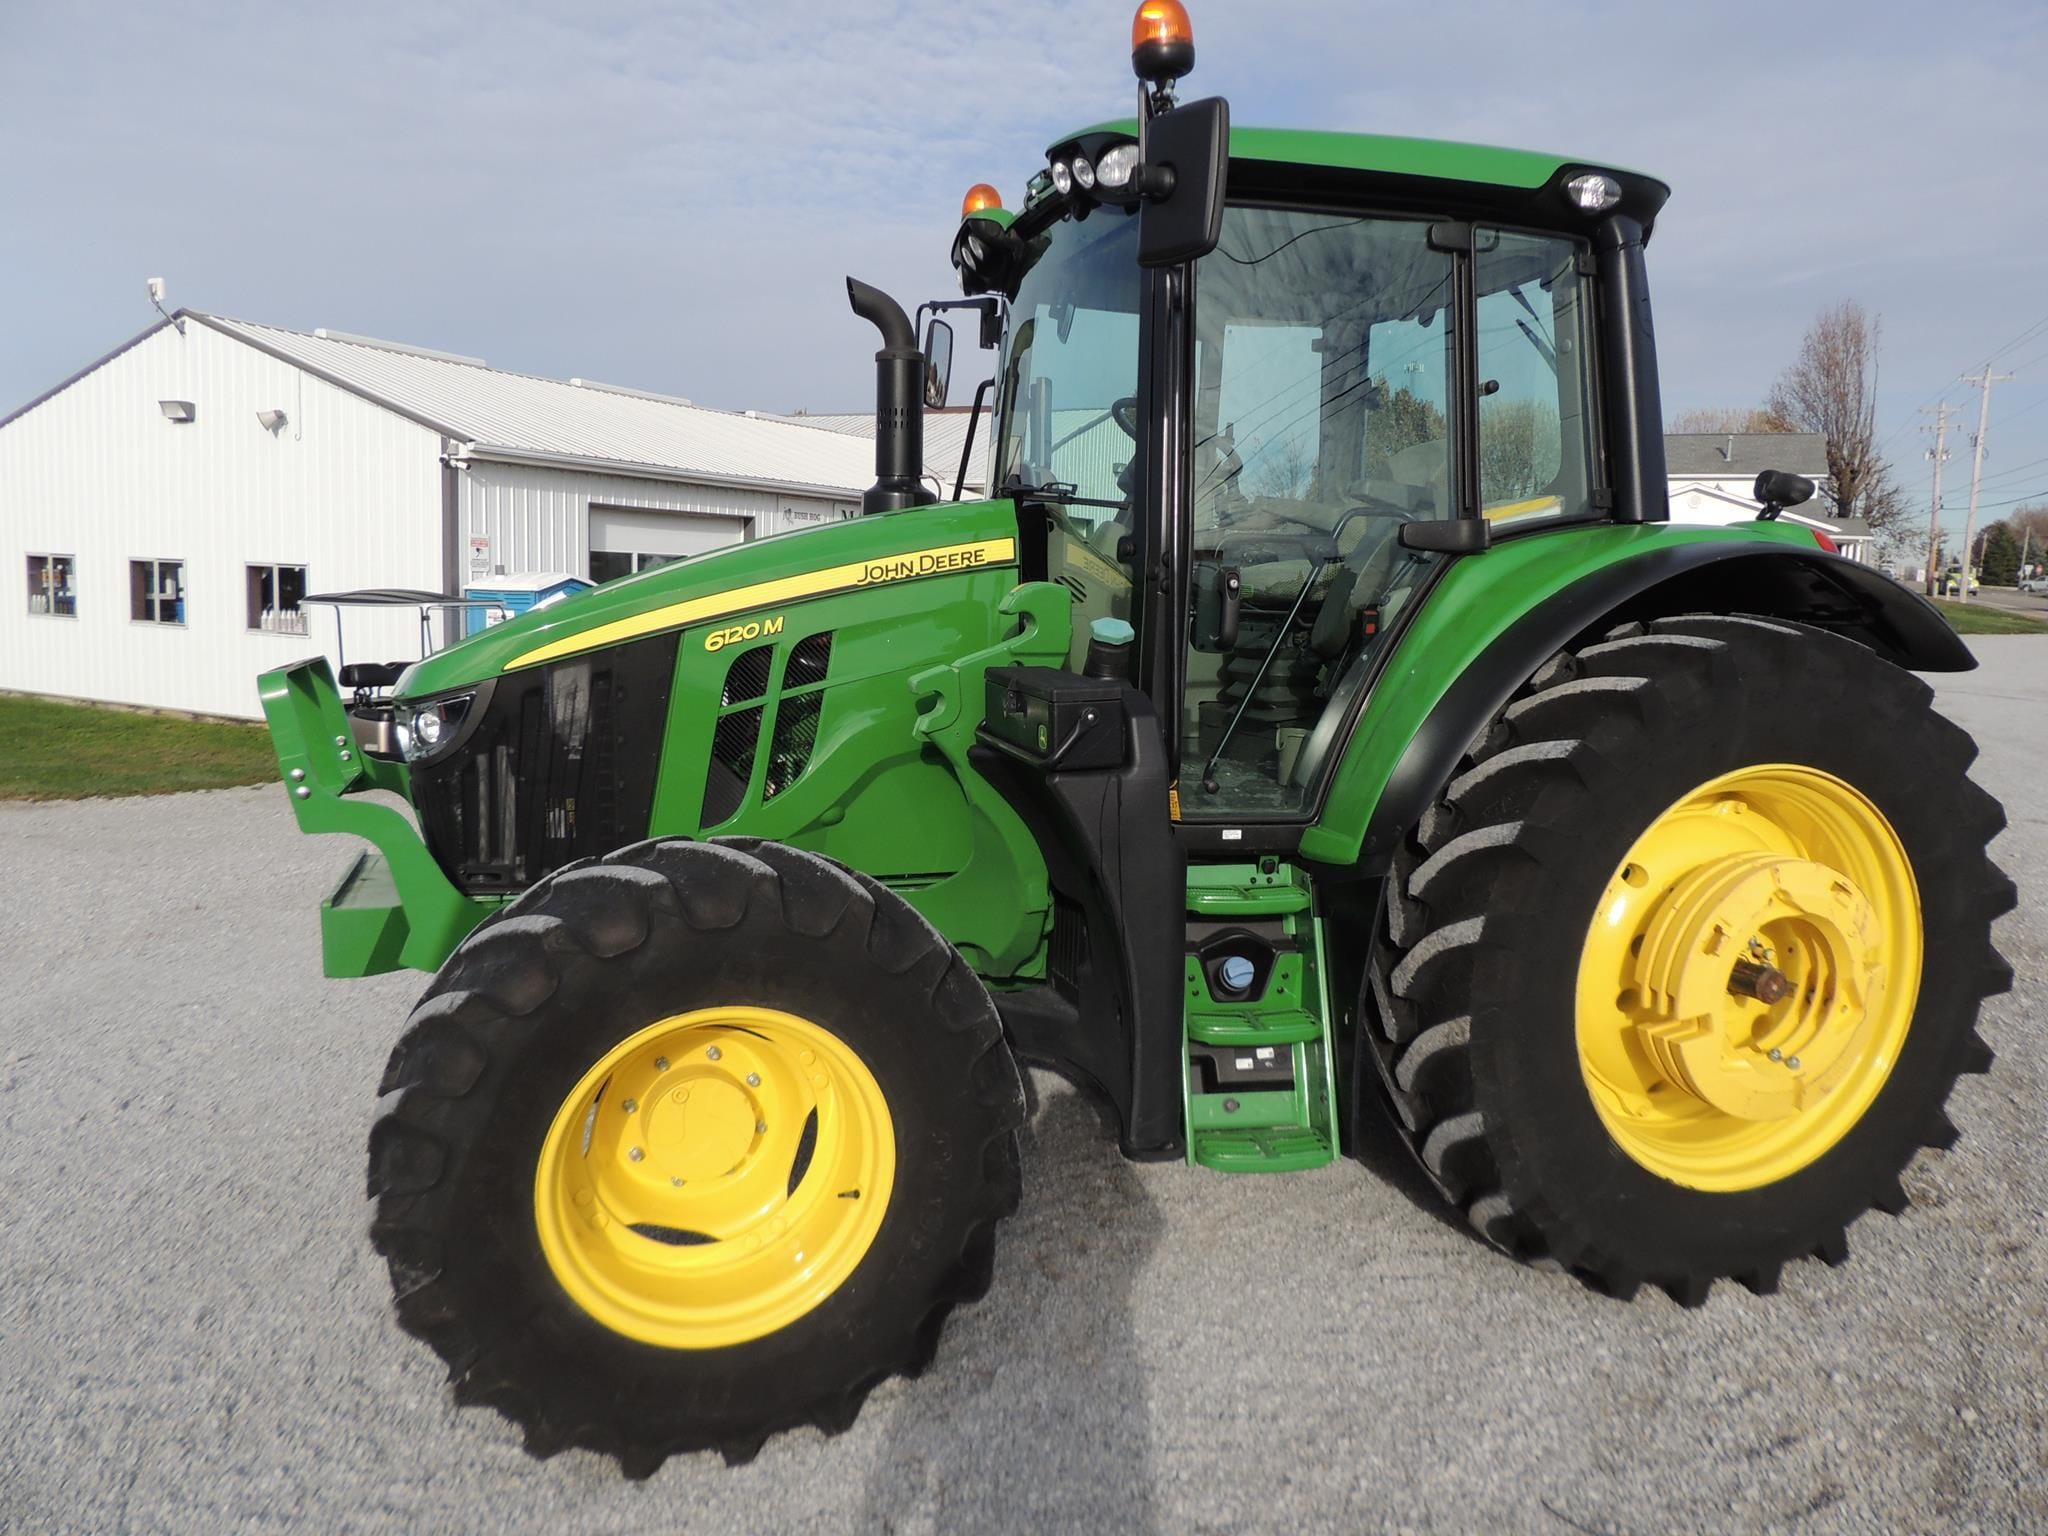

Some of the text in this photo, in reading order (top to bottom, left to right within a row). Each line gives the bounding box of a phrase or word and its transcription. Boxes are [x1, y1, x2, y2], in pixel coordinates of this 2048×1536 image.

[857, 549, 986, 584] JOHN DEERE
[704, 616, 784, 652] 6120 M
